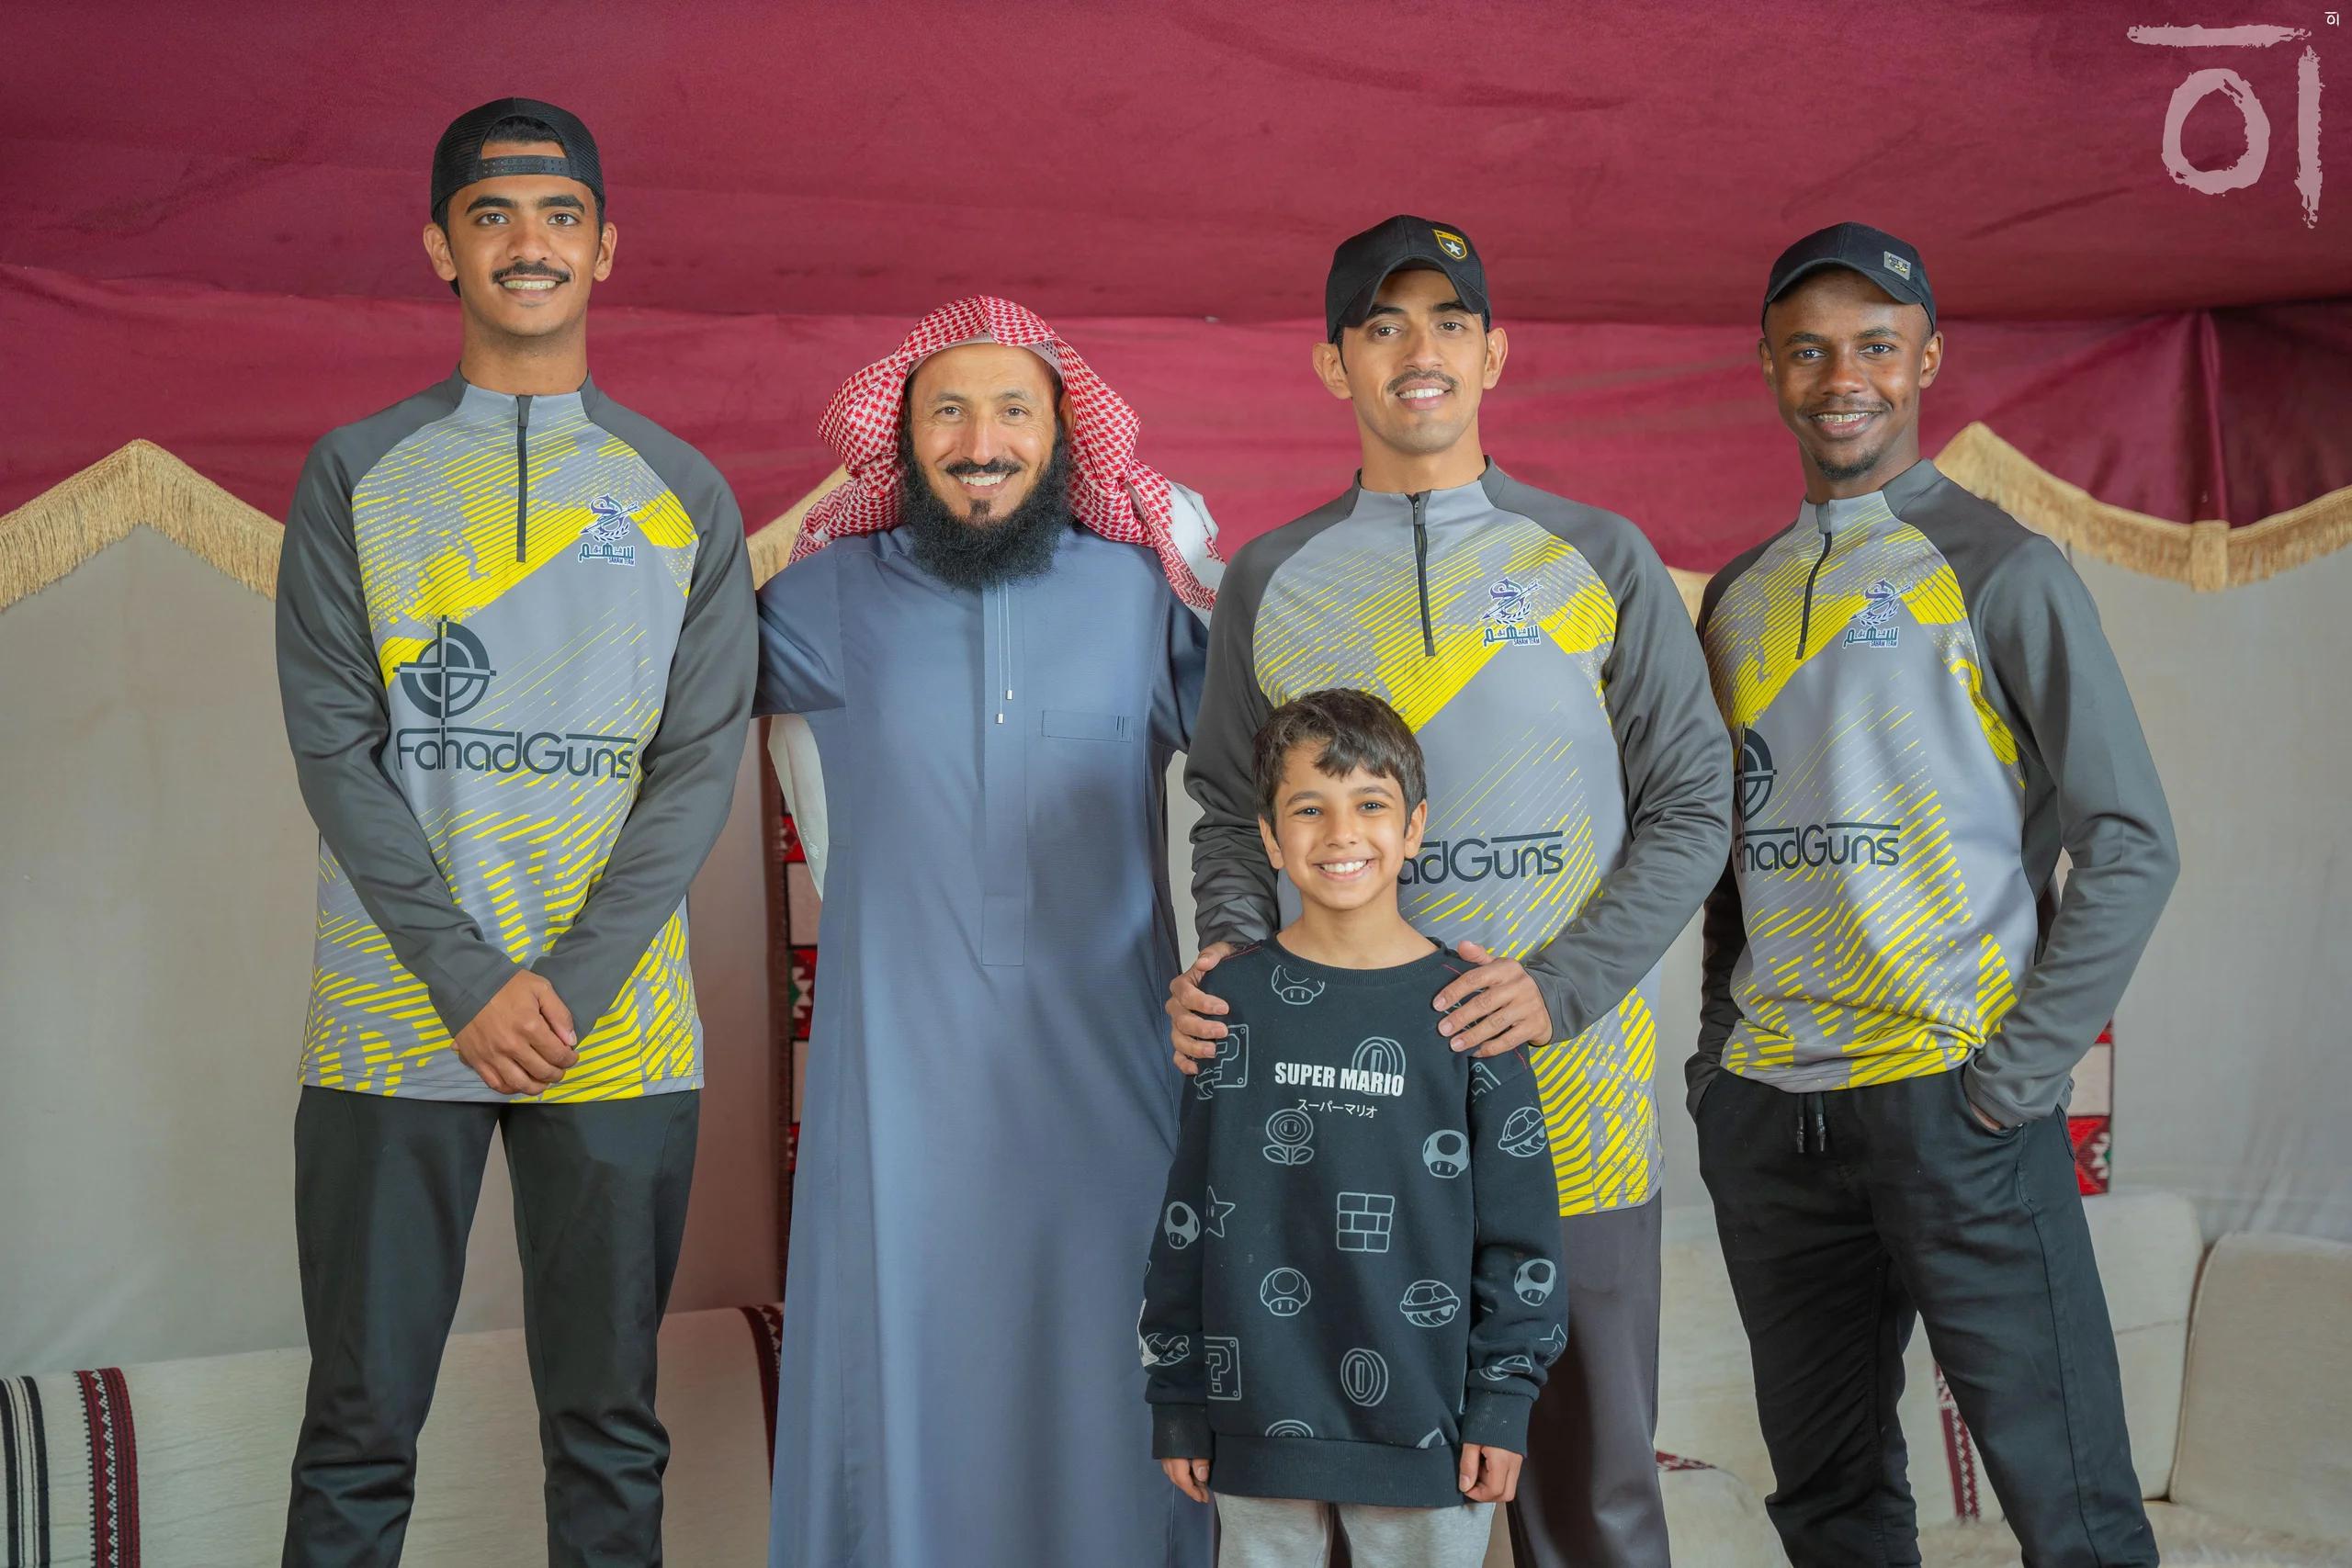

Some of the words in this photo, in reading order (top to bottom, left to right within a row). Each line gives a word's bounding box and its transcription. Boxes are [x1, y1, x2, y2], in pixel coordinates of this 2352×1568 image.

[397, 726, 638, 779] FahadGuns
[1397, 830, 1564, 885] adGuns
[1274, 1062, 1336, 1089] SUPER
[1340, 1068, 1405, 1097] MARIO
[1297, 1099, 1378, 1119] スーパーマリオ
